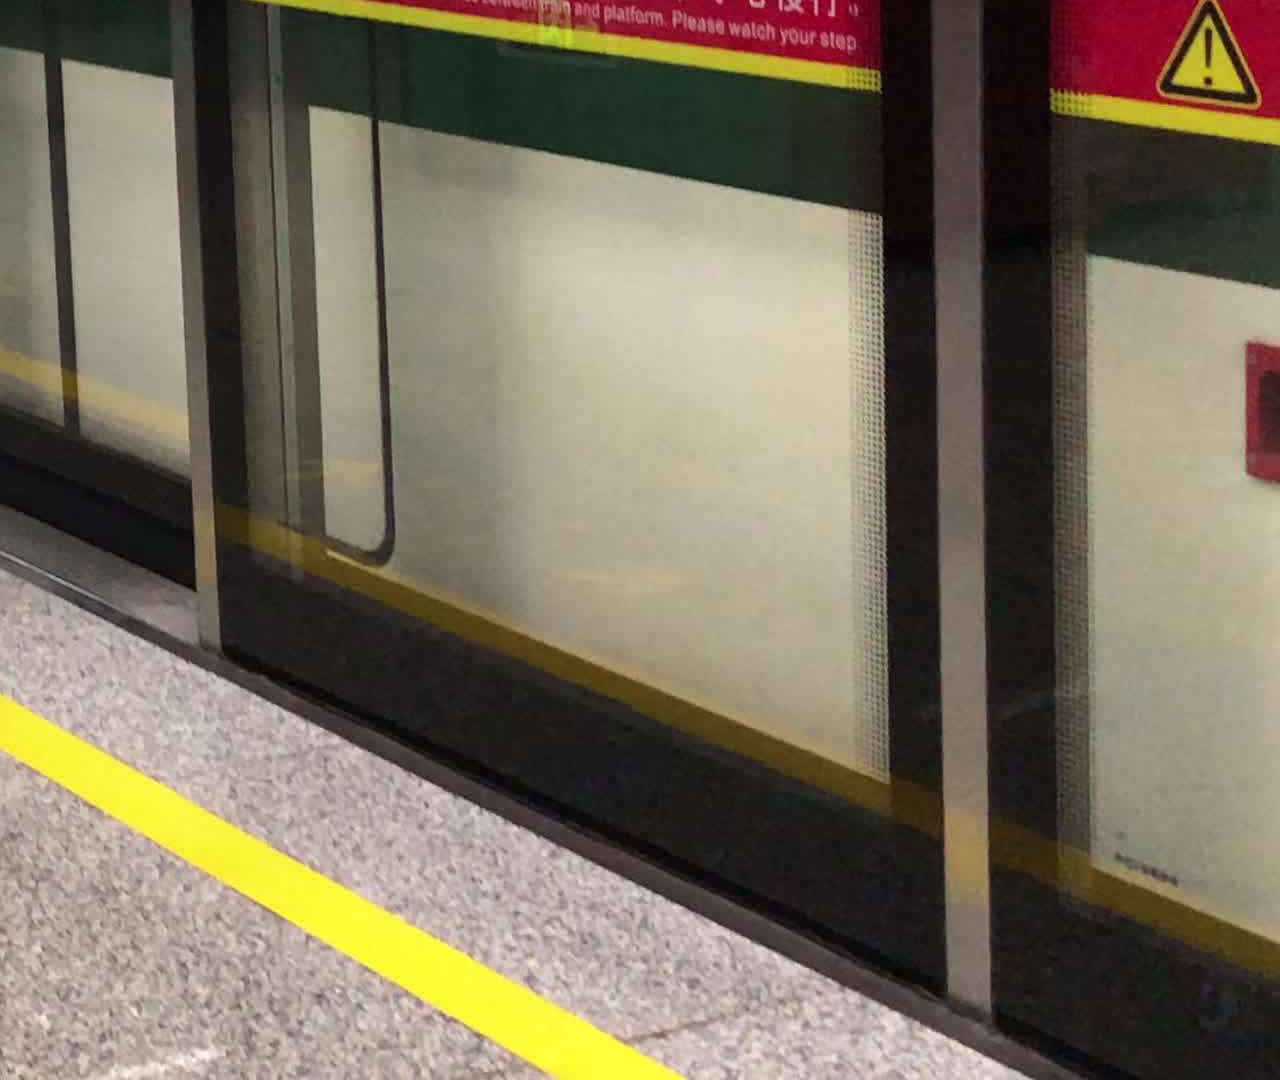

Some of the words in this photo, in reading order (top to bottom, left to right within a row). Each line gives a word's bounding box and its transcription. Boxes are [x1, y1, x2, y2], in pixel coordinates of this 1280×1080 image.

[574, 0, 600, 20] and
[672, 9, 726, 36] Please
[729, 17, 776, 43] watch
[779, 27, 817, 48] your
